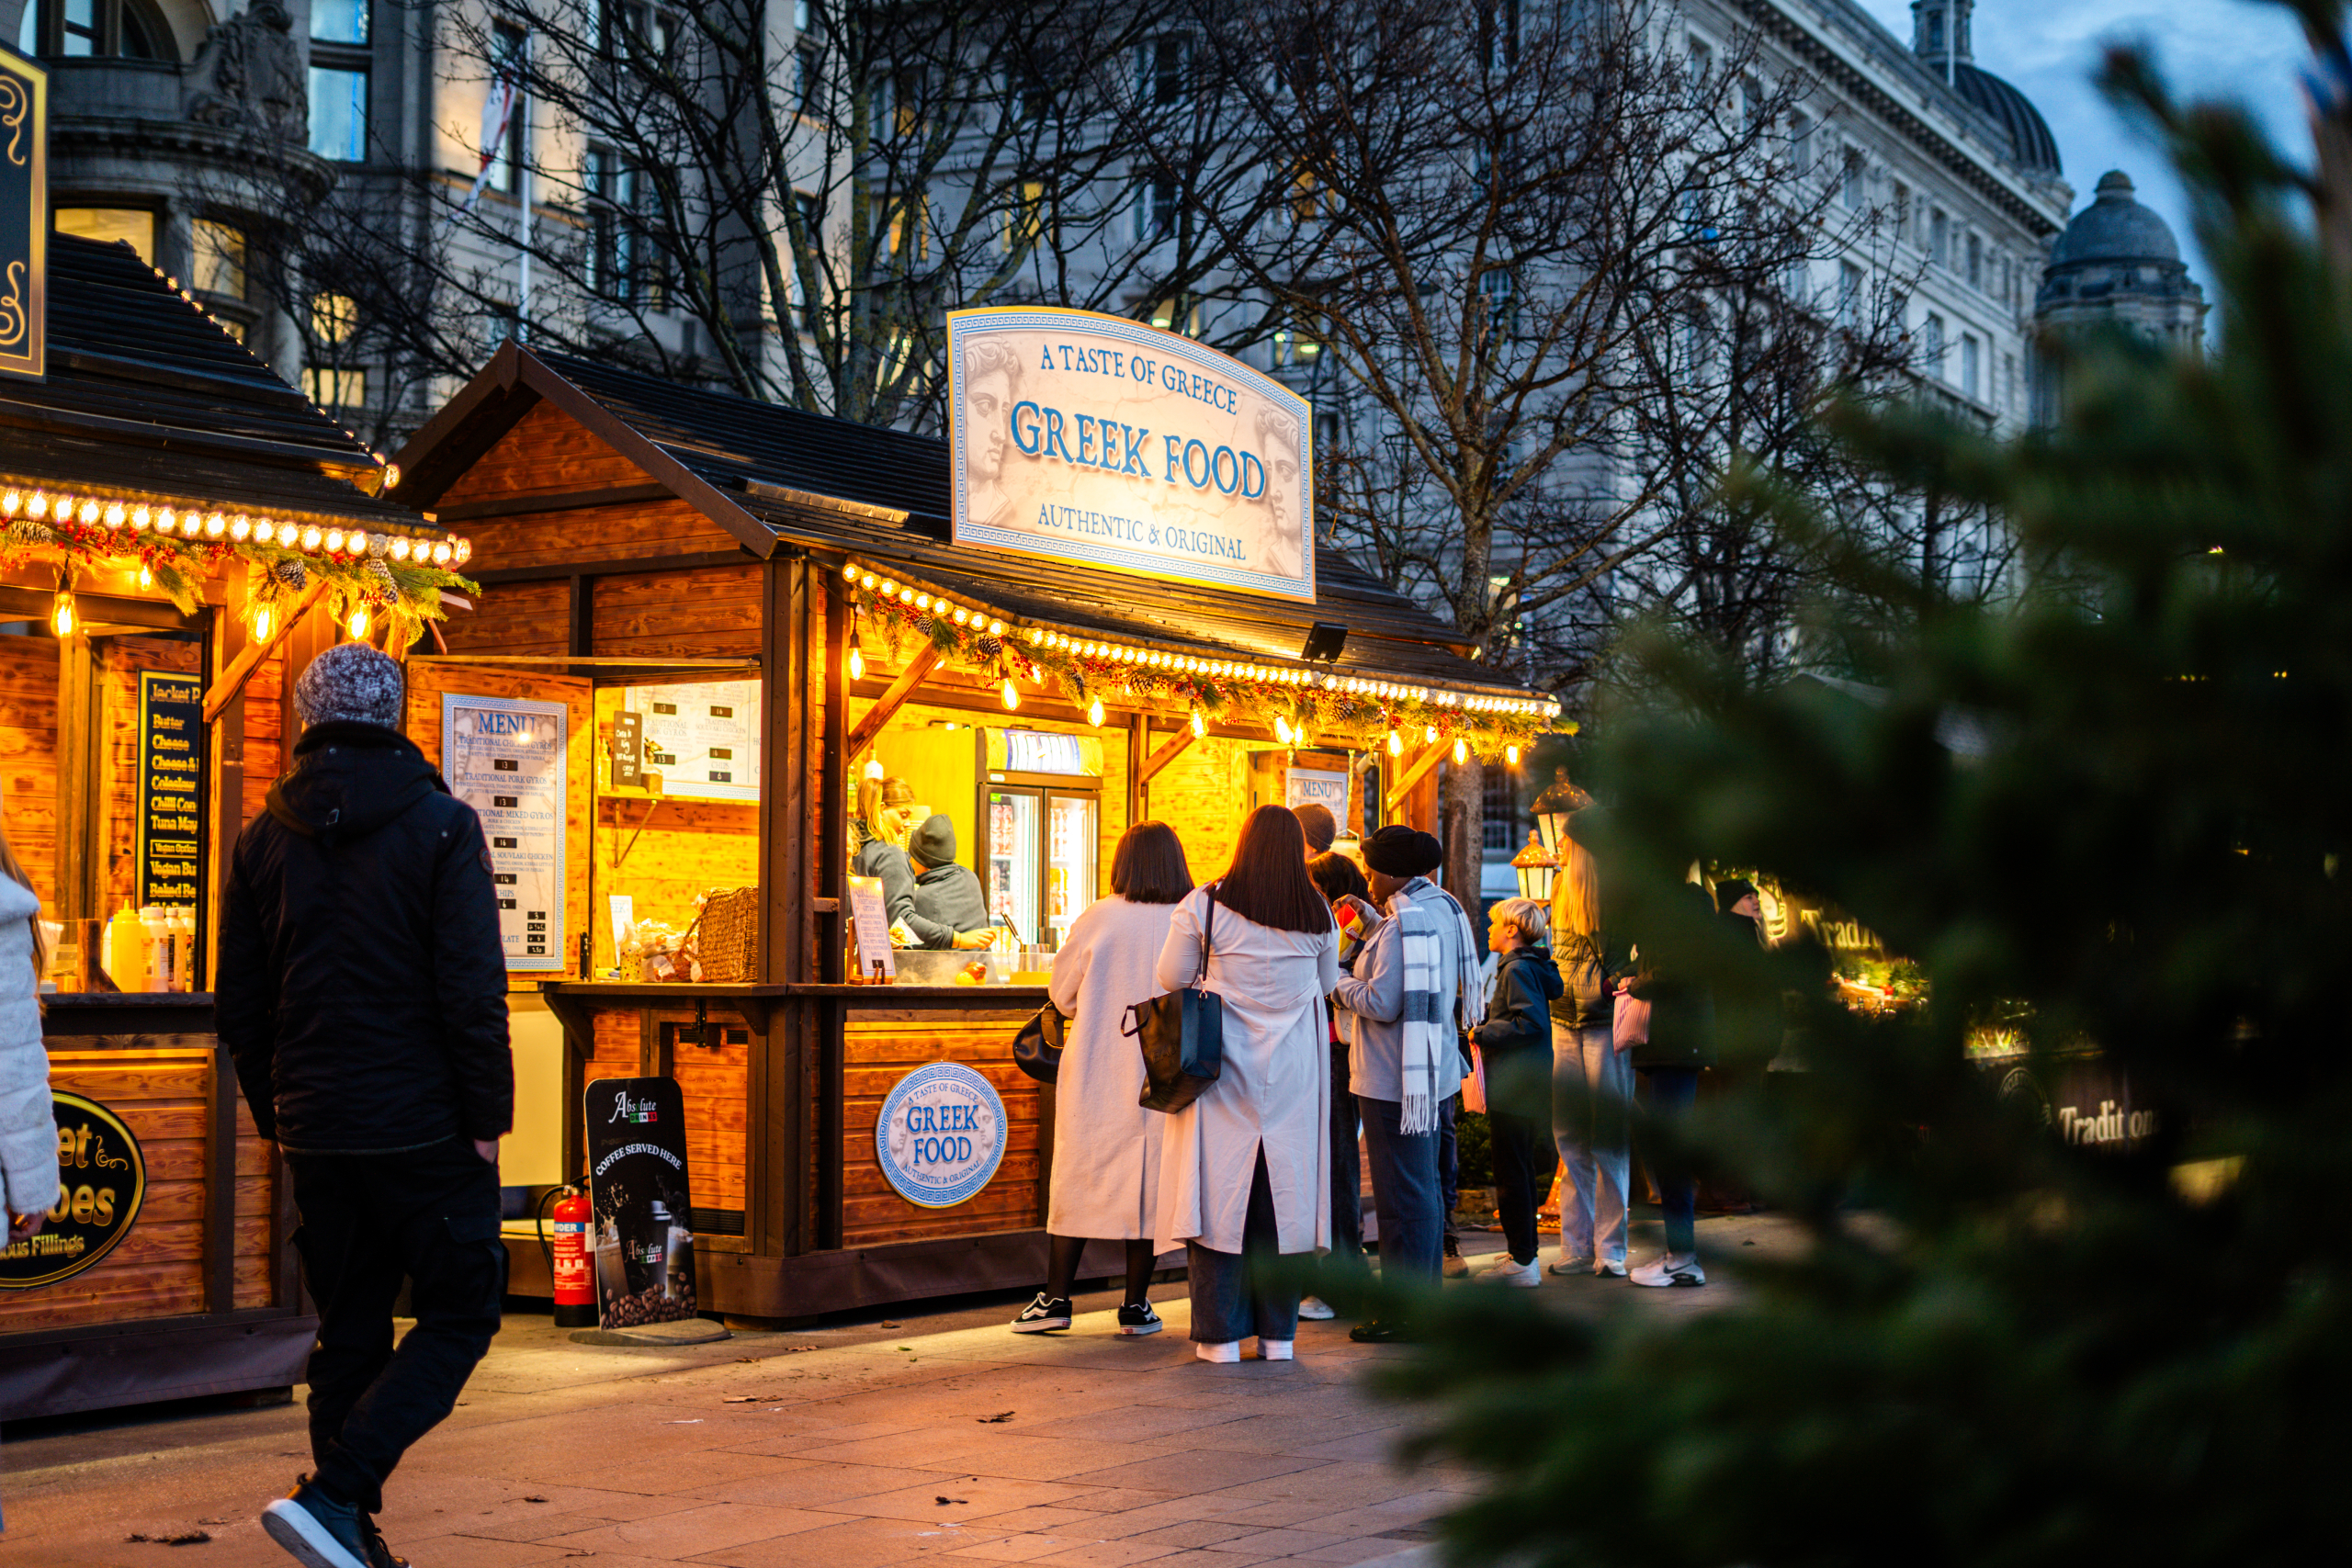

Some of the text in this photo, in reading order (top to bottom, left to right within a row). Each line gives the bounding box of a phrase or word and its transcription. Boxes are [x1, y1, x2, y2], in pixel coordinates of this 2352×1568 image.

[1041, 344, 1238, 415] A TASTE OF GREECE
[1011, 400, 1265, 499] GREEK FOOD
[1038, 503, 1246, 560] AUTHENTIC & ORIGINAL
[150, 683, 190, 704] Jacket
[153, 714, 185, 730] Butter
[478, 713, 536, 734] MENU
[152, 734, 189, 750] Cheese
[459, 737, 502, 746] TRADITIONAL
[531, 741, 551, 750] GYROS
[152, 755, 187, 771] Cheese
[188, 757, 196, 773] &
[659, 755, 665, 763] 13
[152, 775, 196, 792] Coleslaw
[465, 773, 506, 782] TRADITIONAL
[508, 775, 526, 784] PORK
[1303, 781, 1331, 797] MENU
[177, 797, 196, 812] Con
[151, 815, 176, 829] Tuna
[506, 810, 528, 818] MIXED
[150, 861, 181, 878] Vegan
[502, 875, 509, 884] 14
[150, 883, 181, 897] Baked
[909, 1083, 978, 1105] A TASTE OF GREECE
[608, 1091, 656, 1123] Absolute
[907, 1105, 978, 1133] GREEK
[913, 1136, 972, 1164] FOOD
[596, 1144, 682, 1176] COFFEE SERVED HERE
[903, 1164, 942, 1184] AUTHENTIC
[949, 1160, 981, 1182] ORIGINAL
[32, 1234, 85, 1258] Fillings
